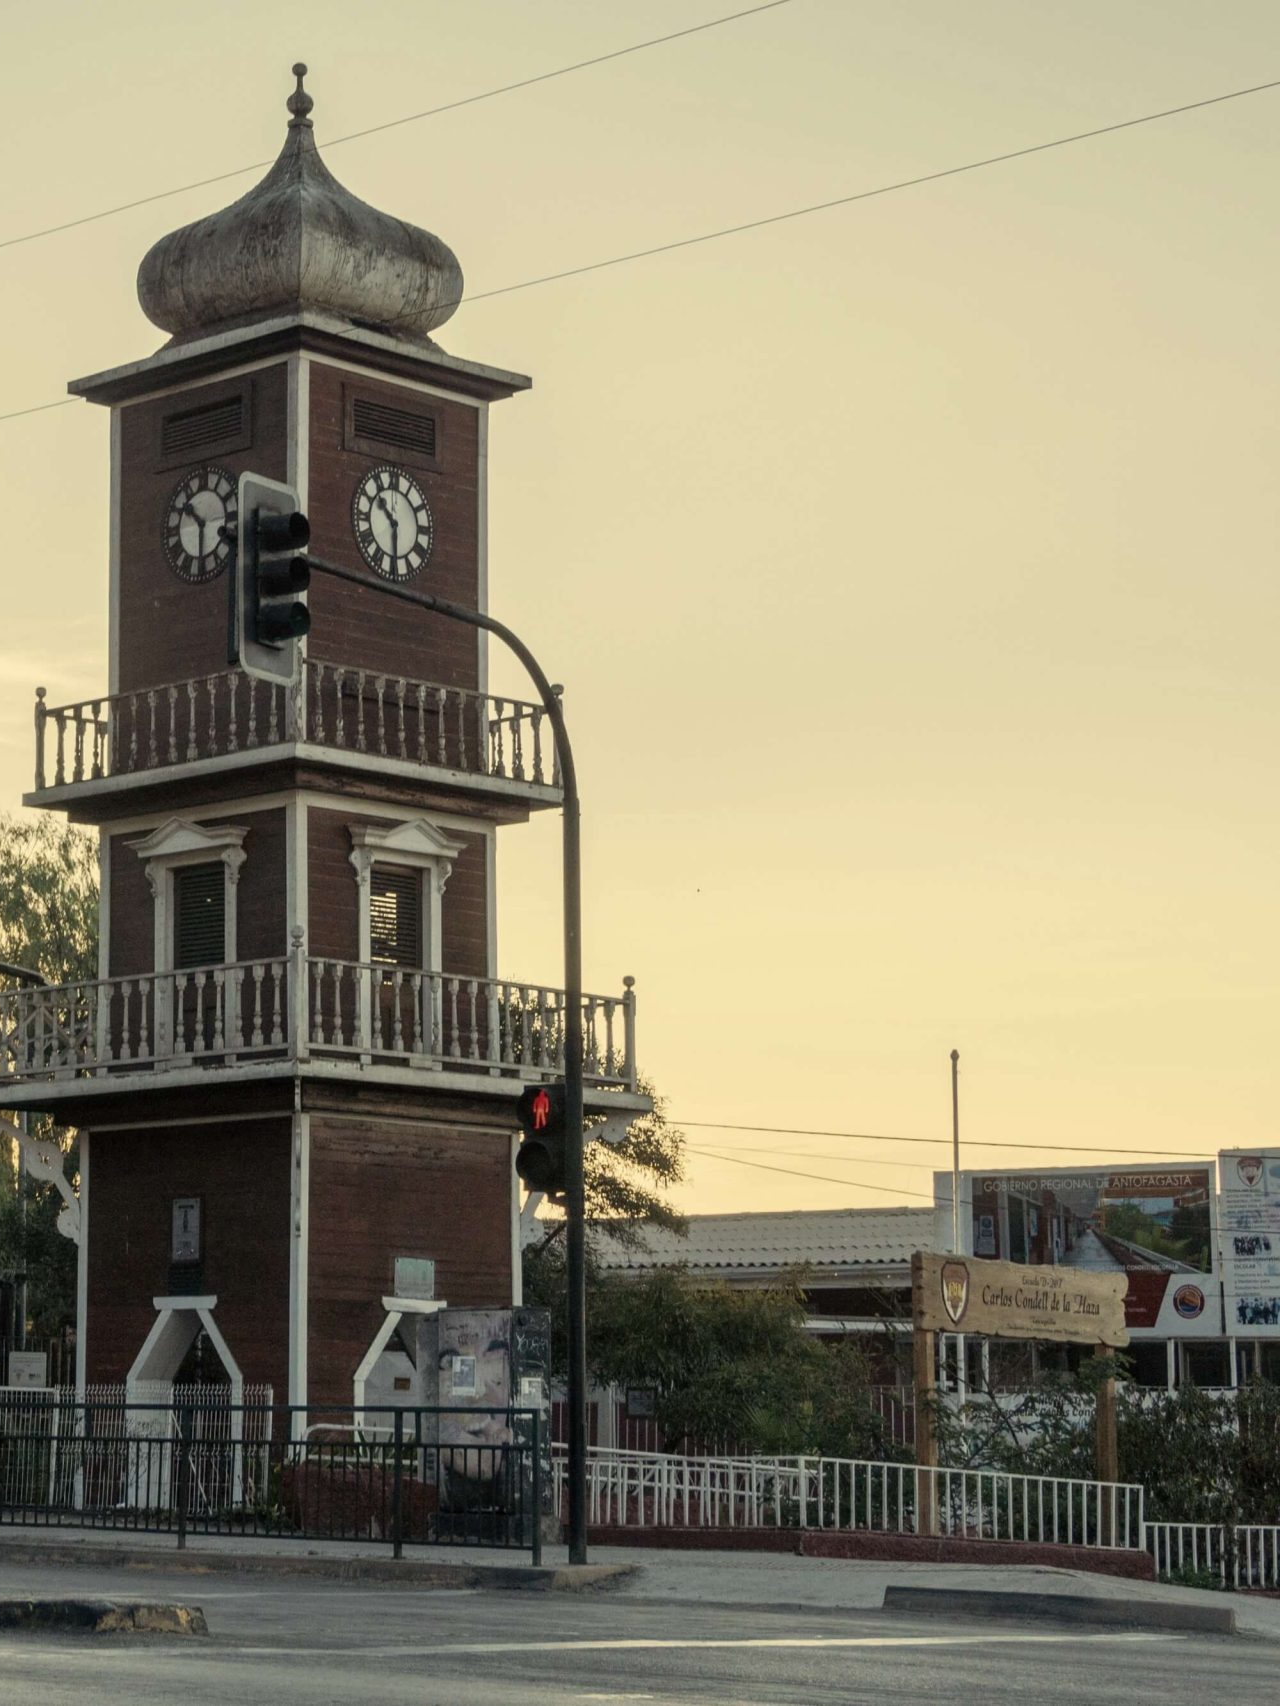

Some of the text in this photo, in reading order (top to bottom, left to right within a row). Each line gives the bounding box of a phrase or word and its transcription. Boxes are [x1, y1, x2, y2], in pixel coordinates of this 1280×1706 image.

[983, 1175, 1192, 1193] GOBIERNO REGIONAL DE ANTOFAGASTA
[982, 1284, 1013, 1307] Carlos
[1015, 1288, 1049, 1311] Condell
[1050, 1291, 1060, 1312] de
[1062, 1292, 1071, 1313] la
[1073, 1294, 1100, 1316] Haza
